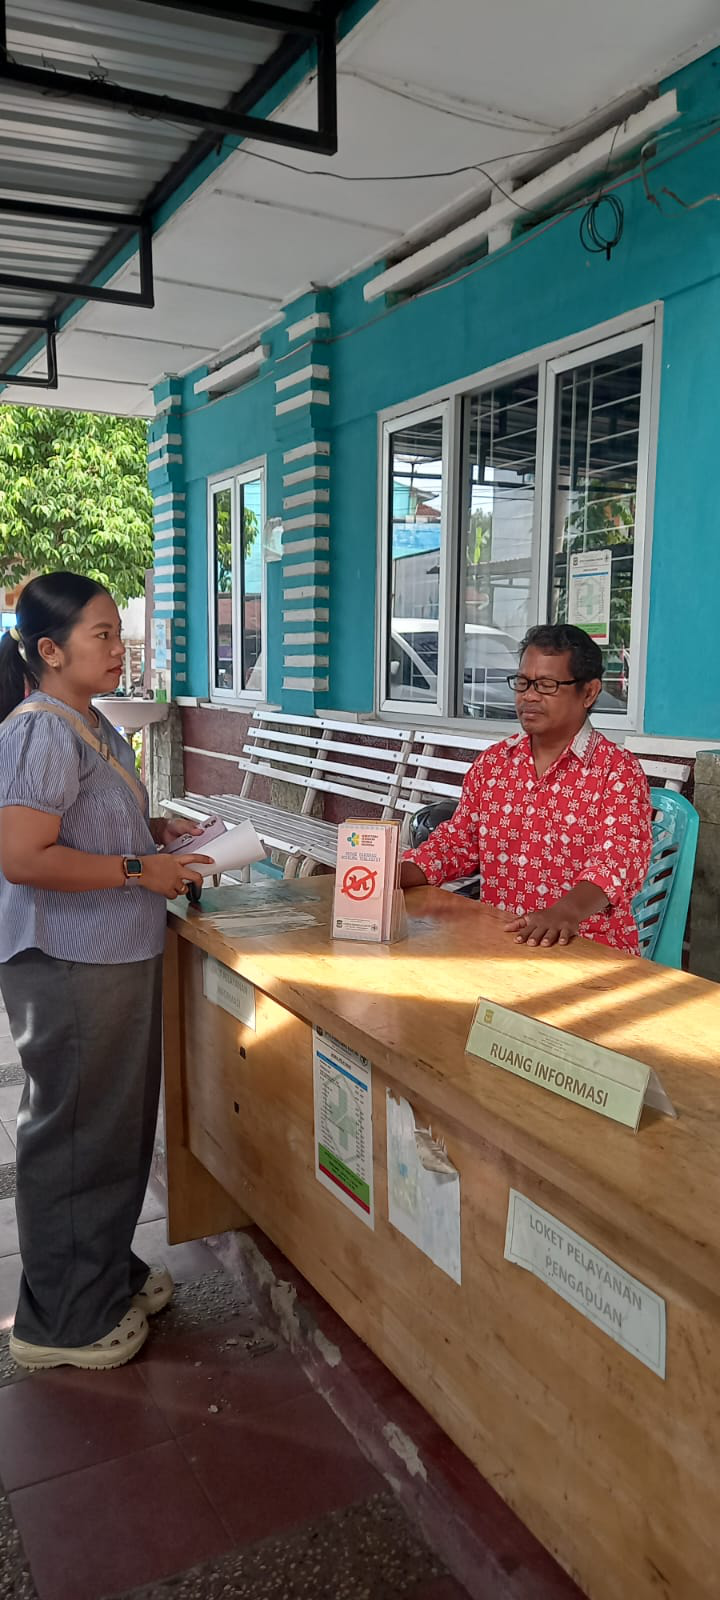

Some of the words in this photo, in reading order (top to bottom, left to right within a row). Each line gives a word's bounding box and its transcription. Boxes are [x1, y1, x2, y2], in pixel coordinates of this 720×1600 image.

[490, 1043, 532, 1073] RUANG
[534, 1062, 609, 1108] INFORMASI
[529, 1214, 564, 1249] LOKET
[567, 1242, 642, 1311] PELAYANAN
[545, 1255, 623, 1328] PENGADUAN
